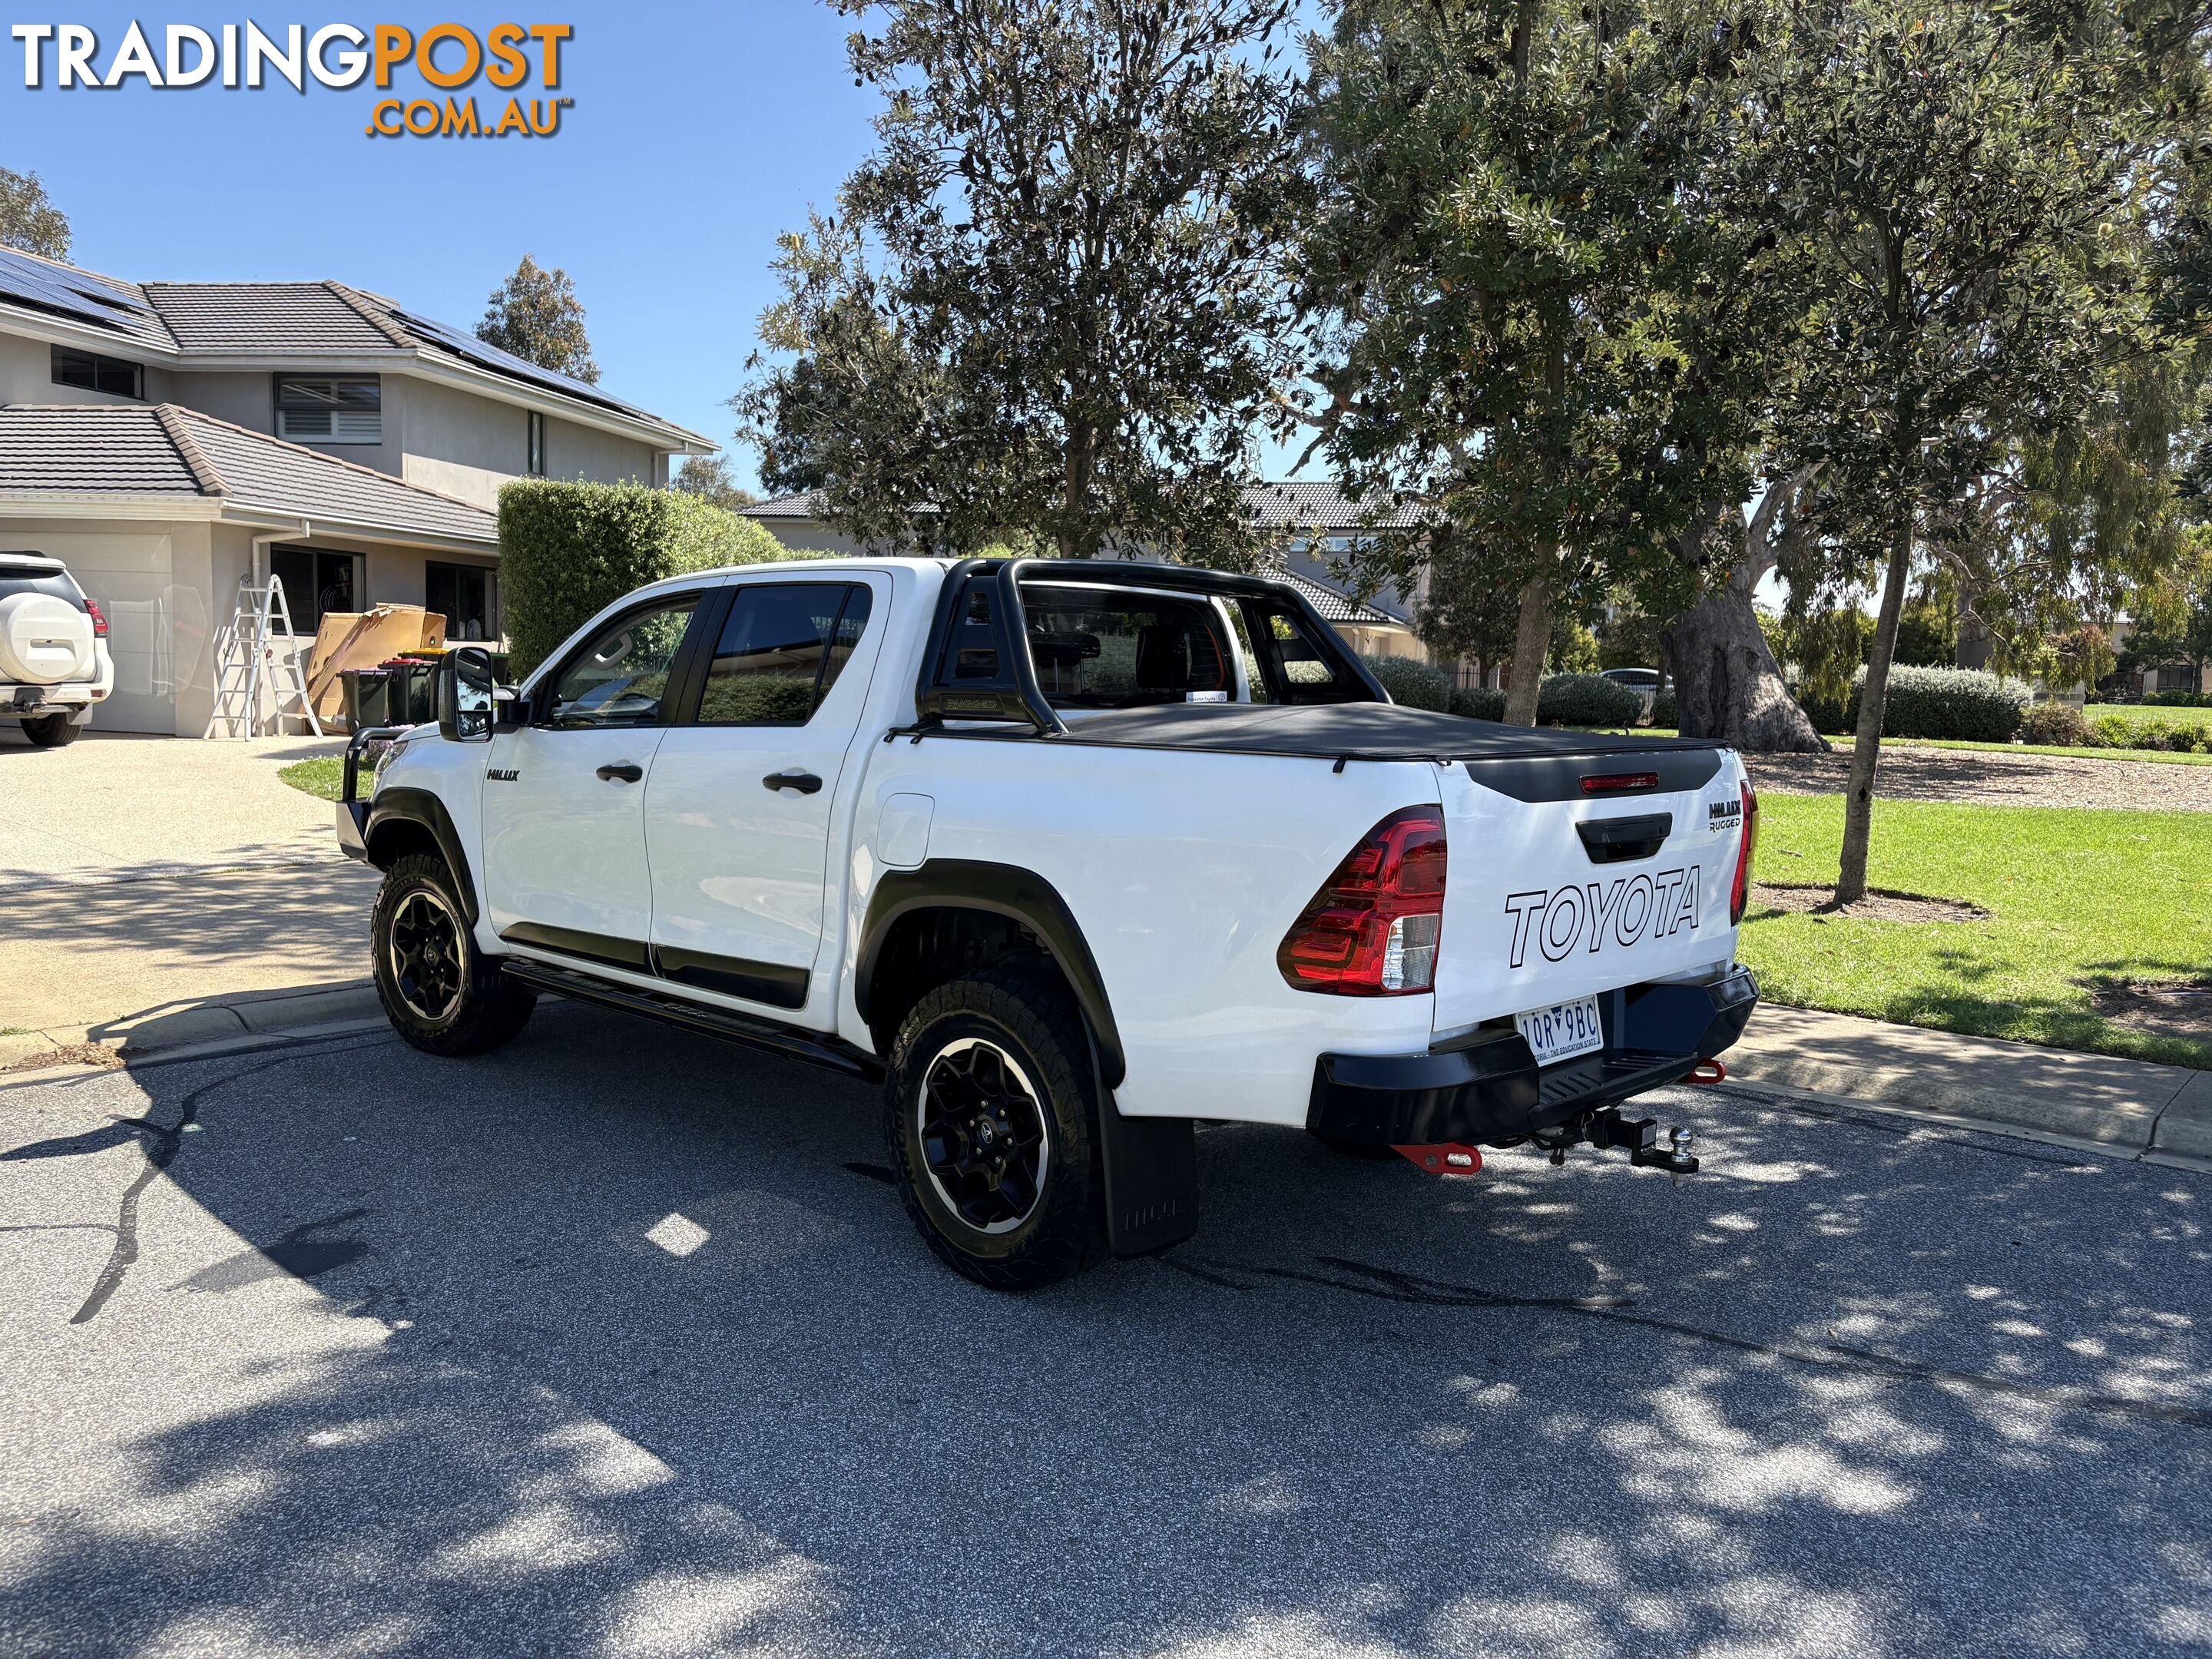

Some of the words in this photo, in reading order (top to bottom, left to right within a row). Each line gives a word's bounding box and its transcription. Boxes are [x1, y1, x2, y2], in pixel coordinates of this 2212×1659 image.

[947, 699, 998, 710] RUGGED
[486, 769, 520, 782] HILUX
[1709, 800, 1741, 820] HILUX
[1709, 818, 1740, 833] RUGGED
[1505, 865, 1700, 969] TOYOTA
[1565, 1003, 1596, 1041] 9BC
[1551, 1048, 1559, 1058] THE
[1560, 1042, 1583, 1055] EDUCATION
[1584, 1038, 1596, 1048] STATE
